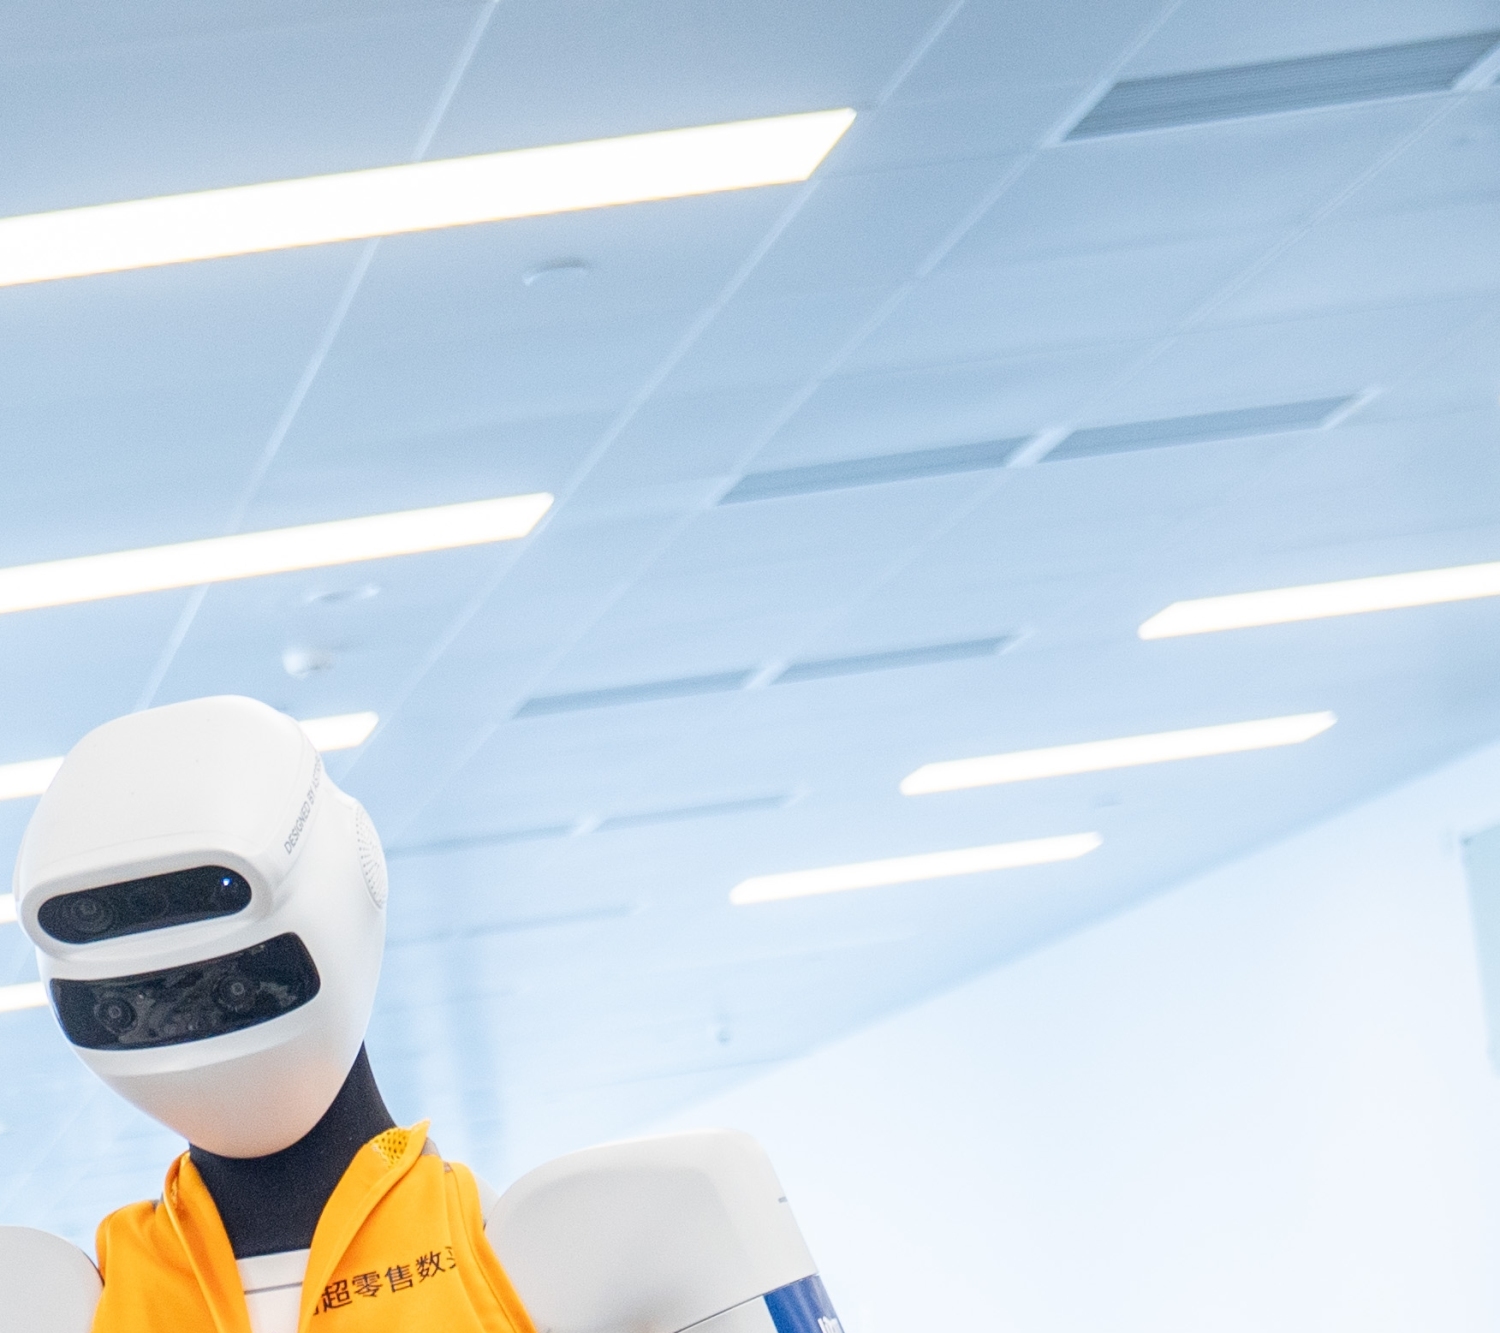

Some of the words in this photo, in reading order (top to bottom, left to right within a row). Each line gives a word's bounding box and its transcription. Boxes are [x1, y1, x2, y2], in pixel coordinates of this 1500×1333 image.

[284, 801, 311, 854] DESIGNED
[313, 1245, 457, 1316] 超零售数
